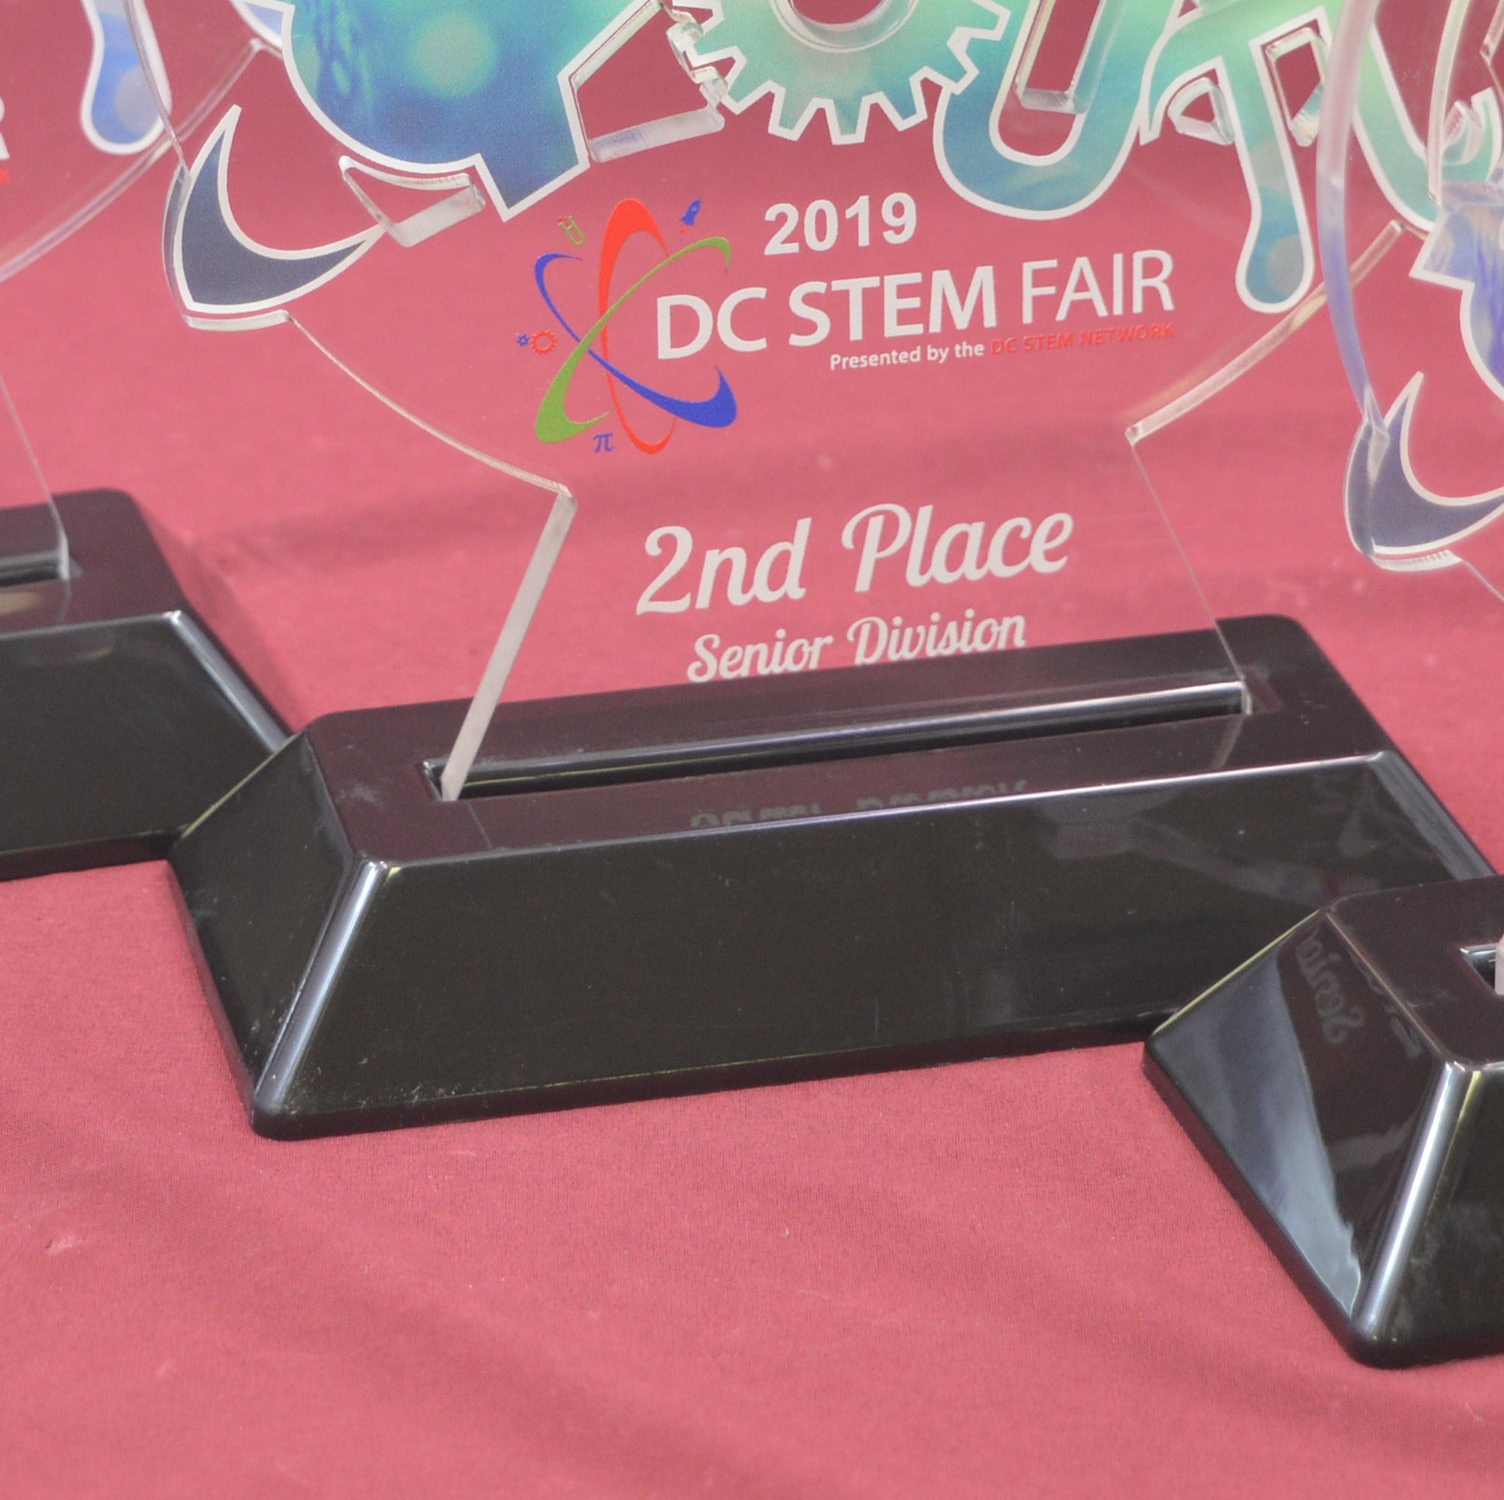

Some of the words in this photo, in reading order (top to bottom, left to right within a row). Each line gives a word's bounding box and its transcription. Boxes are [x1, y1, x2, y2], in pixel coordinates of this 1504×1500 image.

[764, 193, 916, 255] 2019
[657, 287, 767, 359] DC
[789, 266, 996, 349] STEM
[1023, 250, 1174, 324] FAIR
[831, 346, 921, 370] Presented
[927, 345, 949, 363] by
[955, 342, 984, 357] the
[991, 338, 1016, 355] DC
[1025, 333, 1074, 350] STEM
[1080, 324, 1173, 345] NETWORK
[637, 518, 811, 615] 2nd
[842, 504, 1073, 592] Place
[687, 628, 834, 683] Senior
[847, 608, 1026, 665] Division
